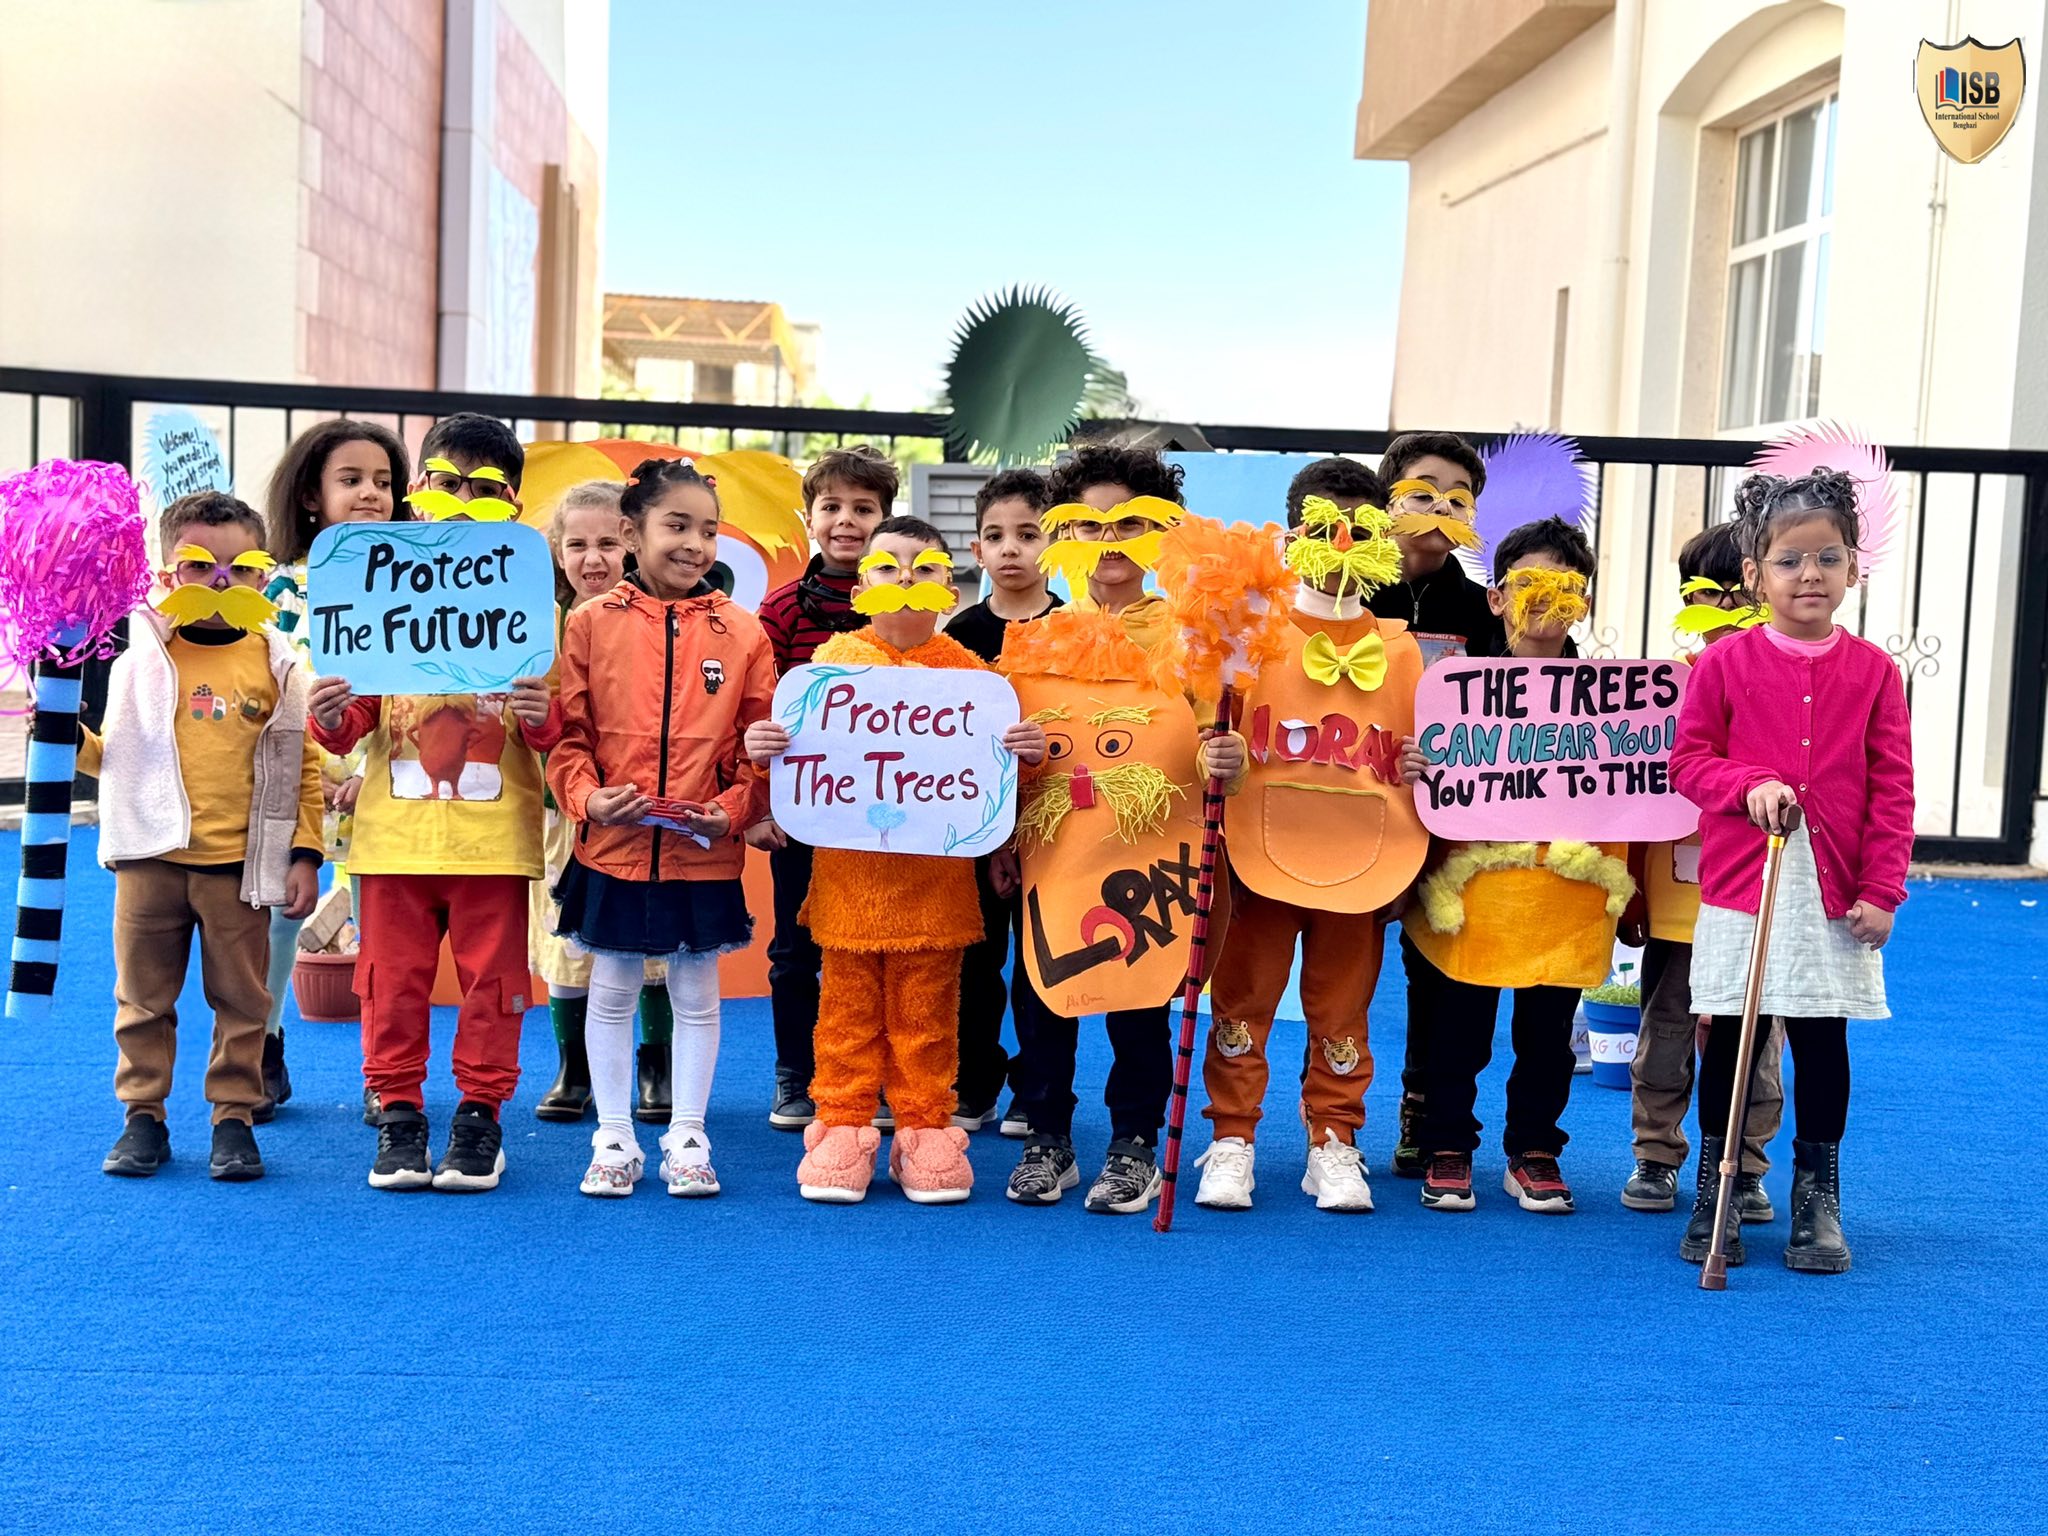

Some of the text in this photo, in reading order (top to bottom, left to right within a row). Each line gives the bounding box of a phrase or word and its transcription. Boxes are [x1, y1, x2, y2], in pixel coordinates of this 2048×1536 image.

[365, 543, 515, 594] Protect
[313, 604, 527, 656] The Future
[821, 683, 975, 737] Protect
[1444, 664, 1679, 719] THE TREES
[1419, 722, 1502, 767] CAN
[1509, 721, 1598, 765] HEAR
[783, 752, 979, 807] The Trees
[1599, 761, 1677, 795] THE
[1028, 842, 1200, 989] LORAX
[1592, 1039, 1609, 1054] KG
